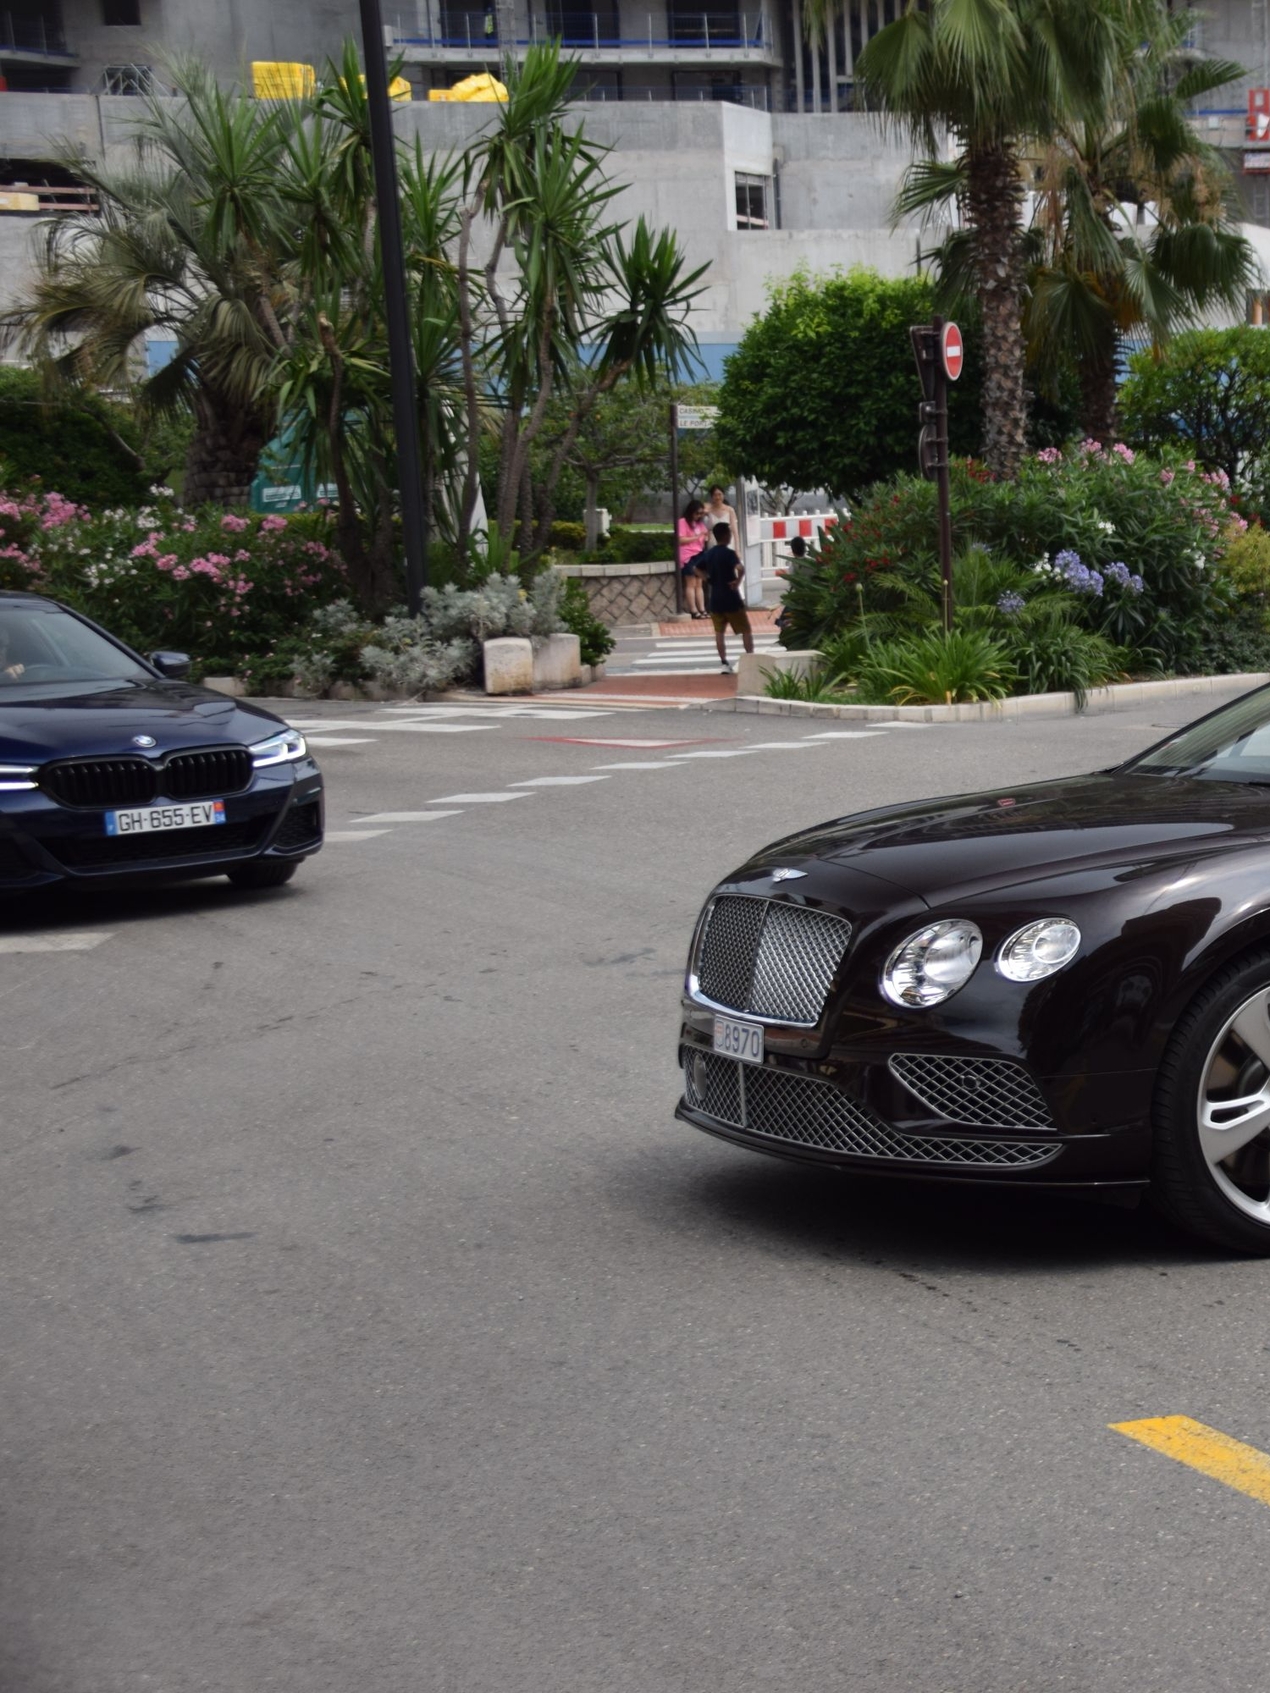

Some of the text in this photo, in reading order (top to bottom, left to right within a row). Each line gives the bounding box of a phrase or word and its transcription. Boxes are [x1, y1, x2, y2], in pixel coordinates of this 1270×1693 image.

[679, 407, 704, 415] CASINO
[118, 805, 212, 832] GH-655-EV
[724, 1024, 760, 1057] 8970
